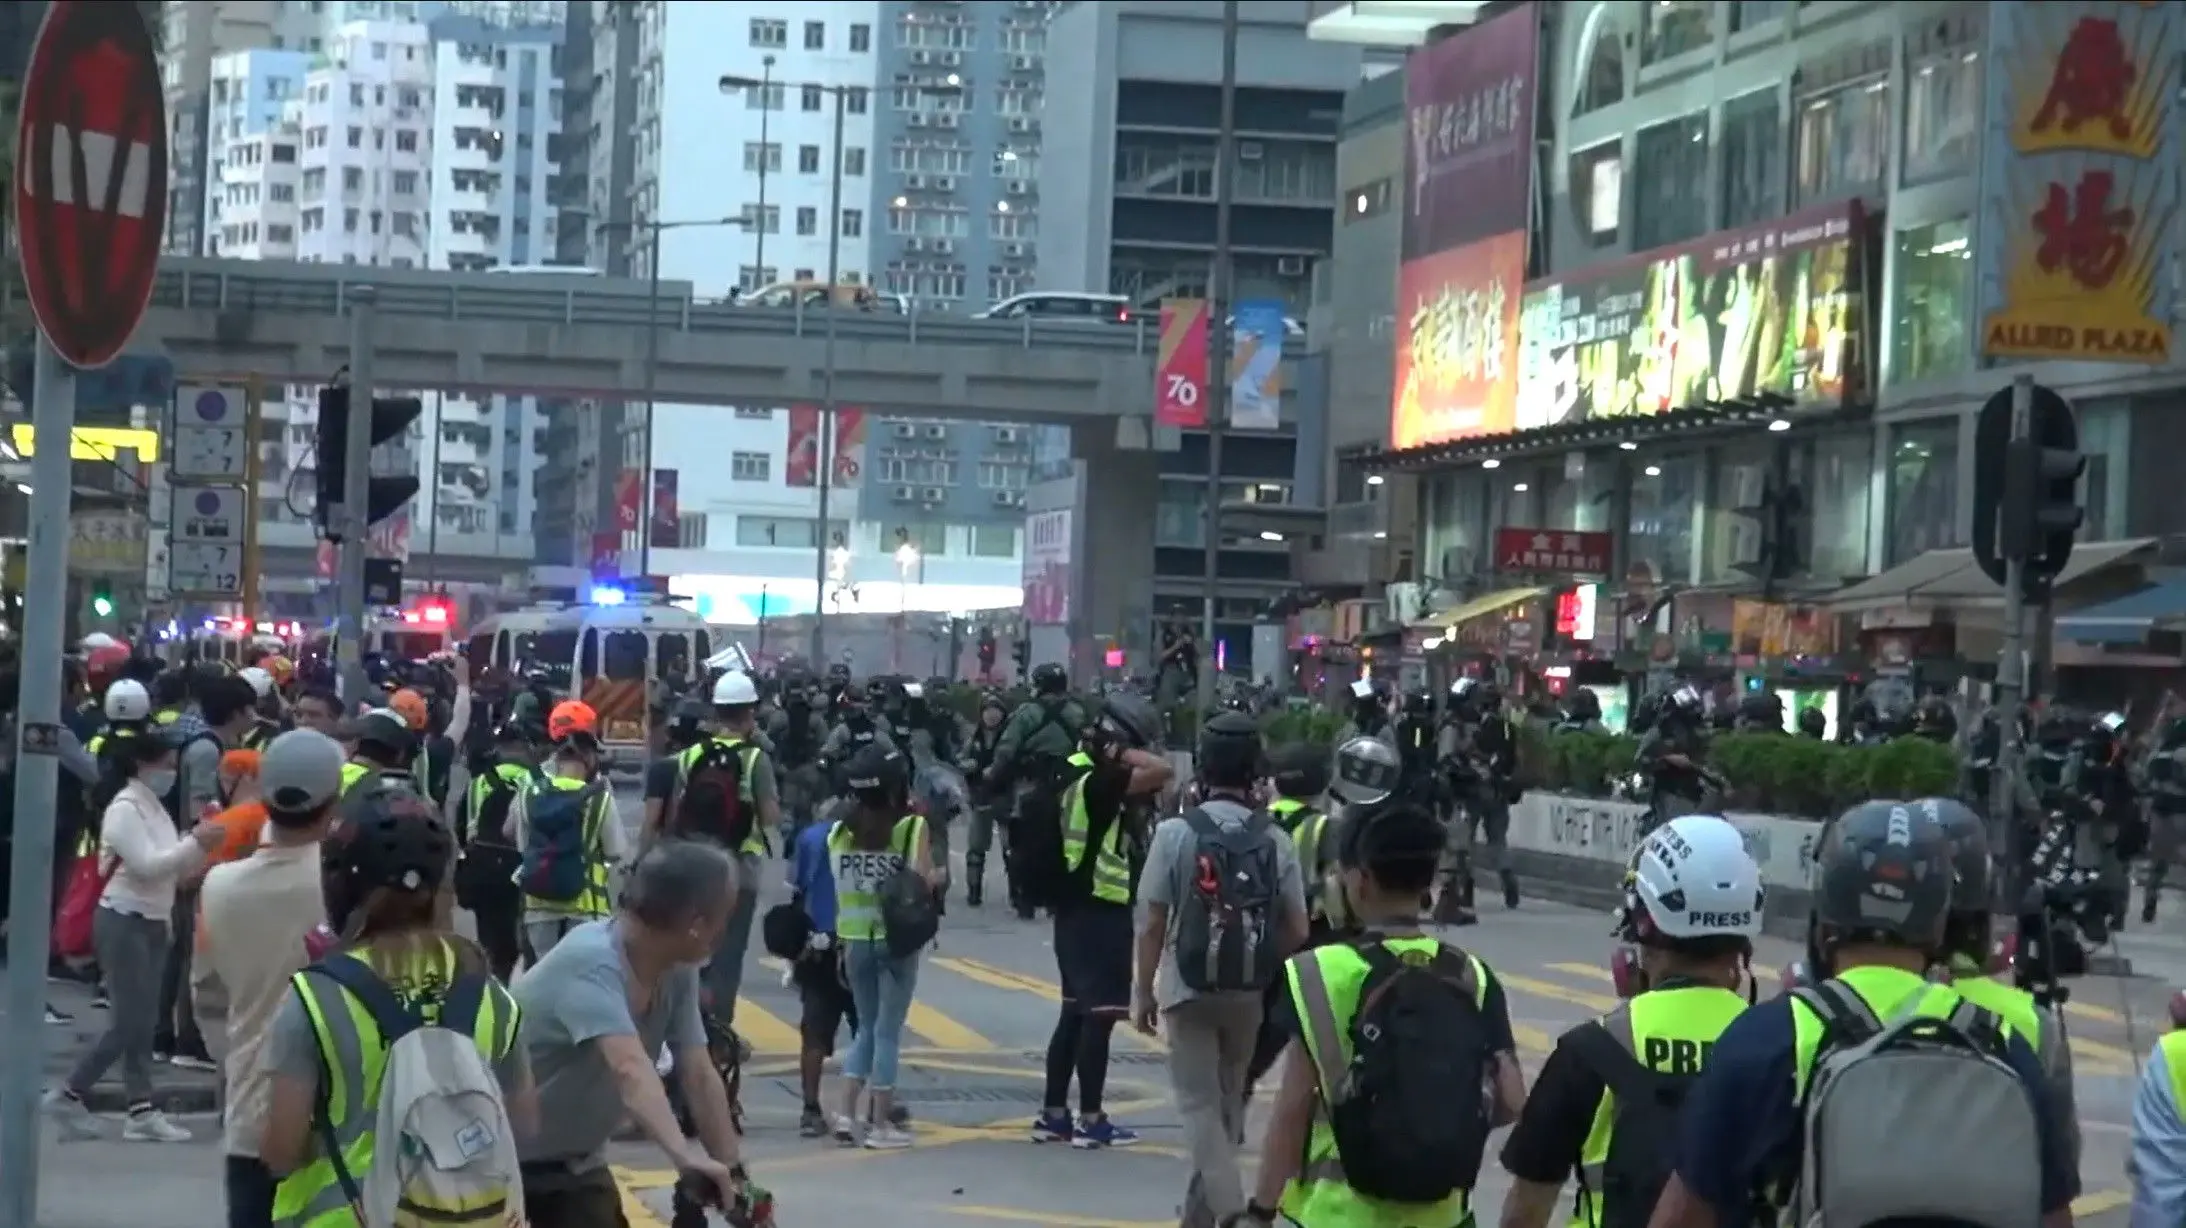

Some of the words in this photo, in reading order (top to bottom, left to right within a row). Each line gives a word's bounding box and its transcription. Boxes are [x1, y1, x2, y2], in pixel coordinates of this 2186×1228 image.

[2030, 15, 2137, 291] 廣場
[1988, 324, 2075, 349] ALLIED
[2082, 327, 2166, 353] PLAZA
[1167, 374, 1197, 406] 70
[216, 573, 237, 589] 12
[840, 854, 904, 880] PRESS
[1688, 911, 1751, 927] PRESS
